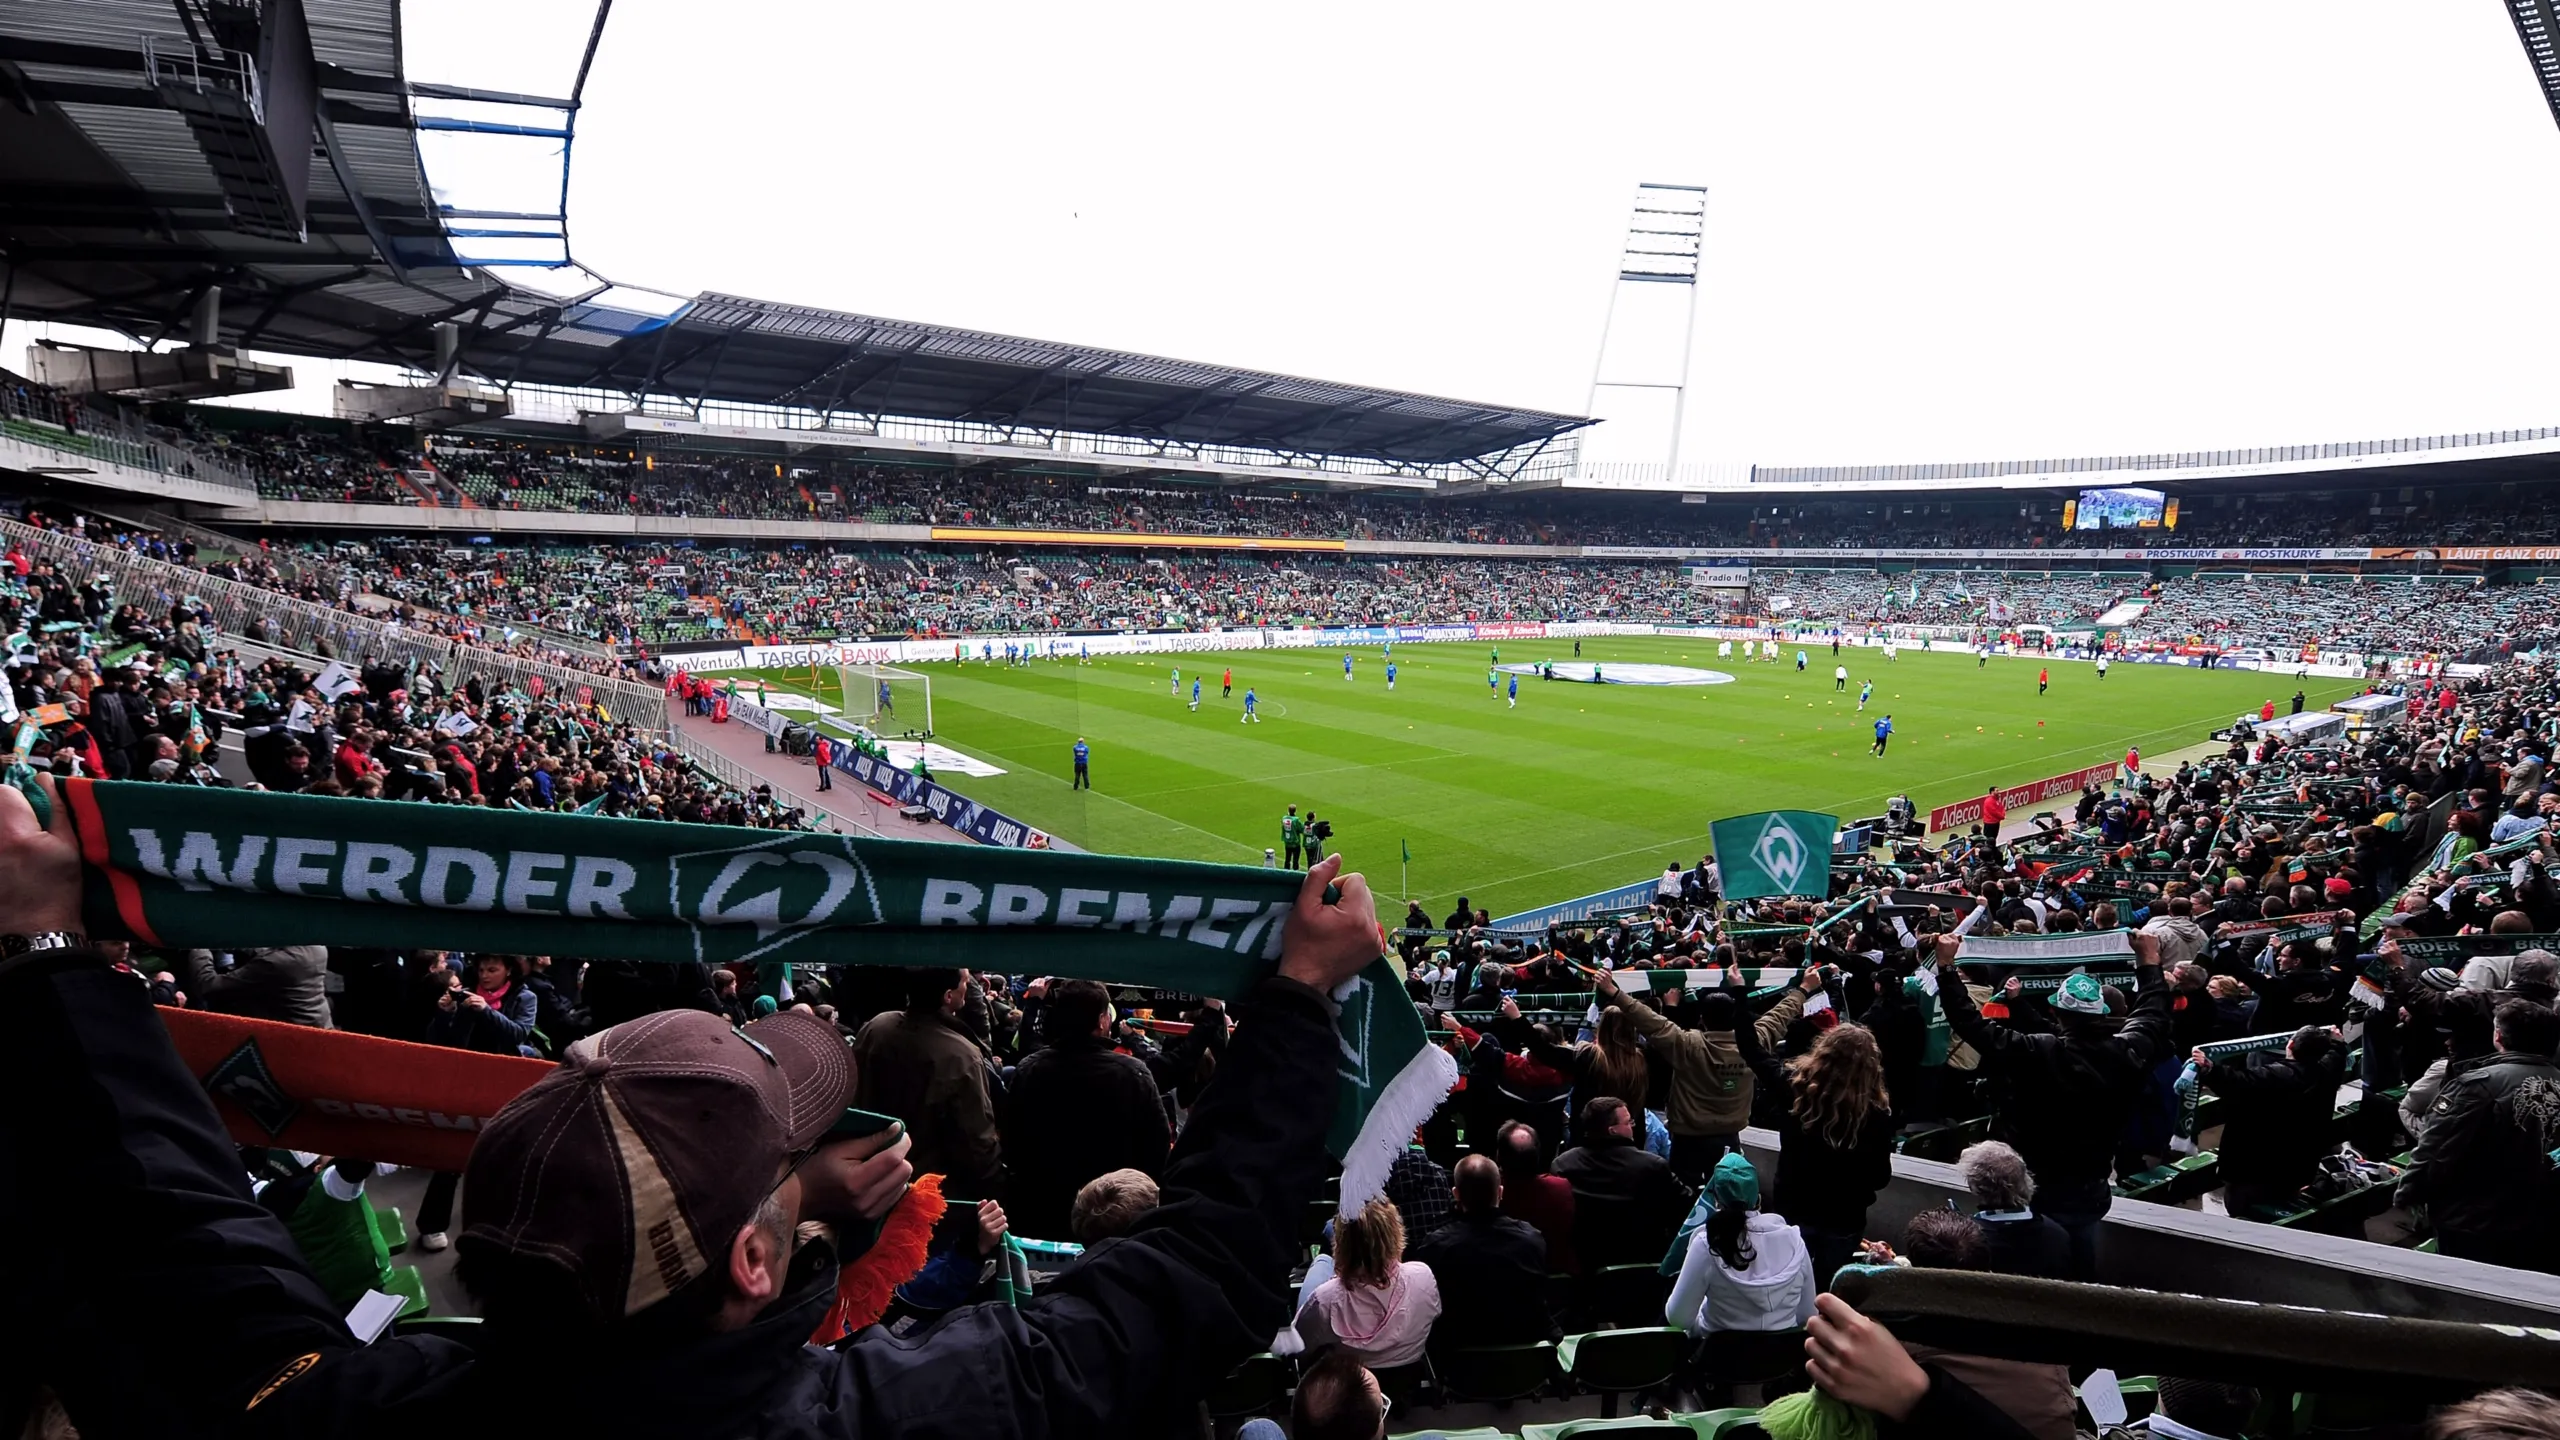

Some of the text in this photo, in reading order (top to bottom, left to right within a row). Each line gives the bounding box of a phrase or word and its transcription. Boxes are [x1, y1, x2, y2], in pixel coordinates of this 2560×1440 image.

[2146, 550, 2217, 559] PROSTKURVE
[2244, 549, 2321, 559] PROSTKURVE
[2447, 547, 2489, 560] LÄUFT
[2493, 548, 2530, 560] GANZ
[1708, 573, 1732, 582] radio
[1734, 573, 1748, 582] ffn
[1315, 630, 1362, 645] fluege.de
[1400, 628, 1422, 638] WODKA
[1423, 626, 1469, 640] GORBATSCHOW
[1169, 636, 1256, 650] TARGO BANK
[665, 650, 740, 672] ProVentus
[758, 648, 891, 666] TARGO BANK
[2216, 732, 2233, 741] sky
[2084, 766, 2114, 787] Adecco
[2041, 777, 2074, 798] Adecco
[1998, 788, 2030, 810] decco
[1940, 798, 1980, 829] Adecco
[128, 828, 638, 921] WERDER
[2515, 937, 2560, 949] BRE
[1432, 980, 1454, 997] 13
